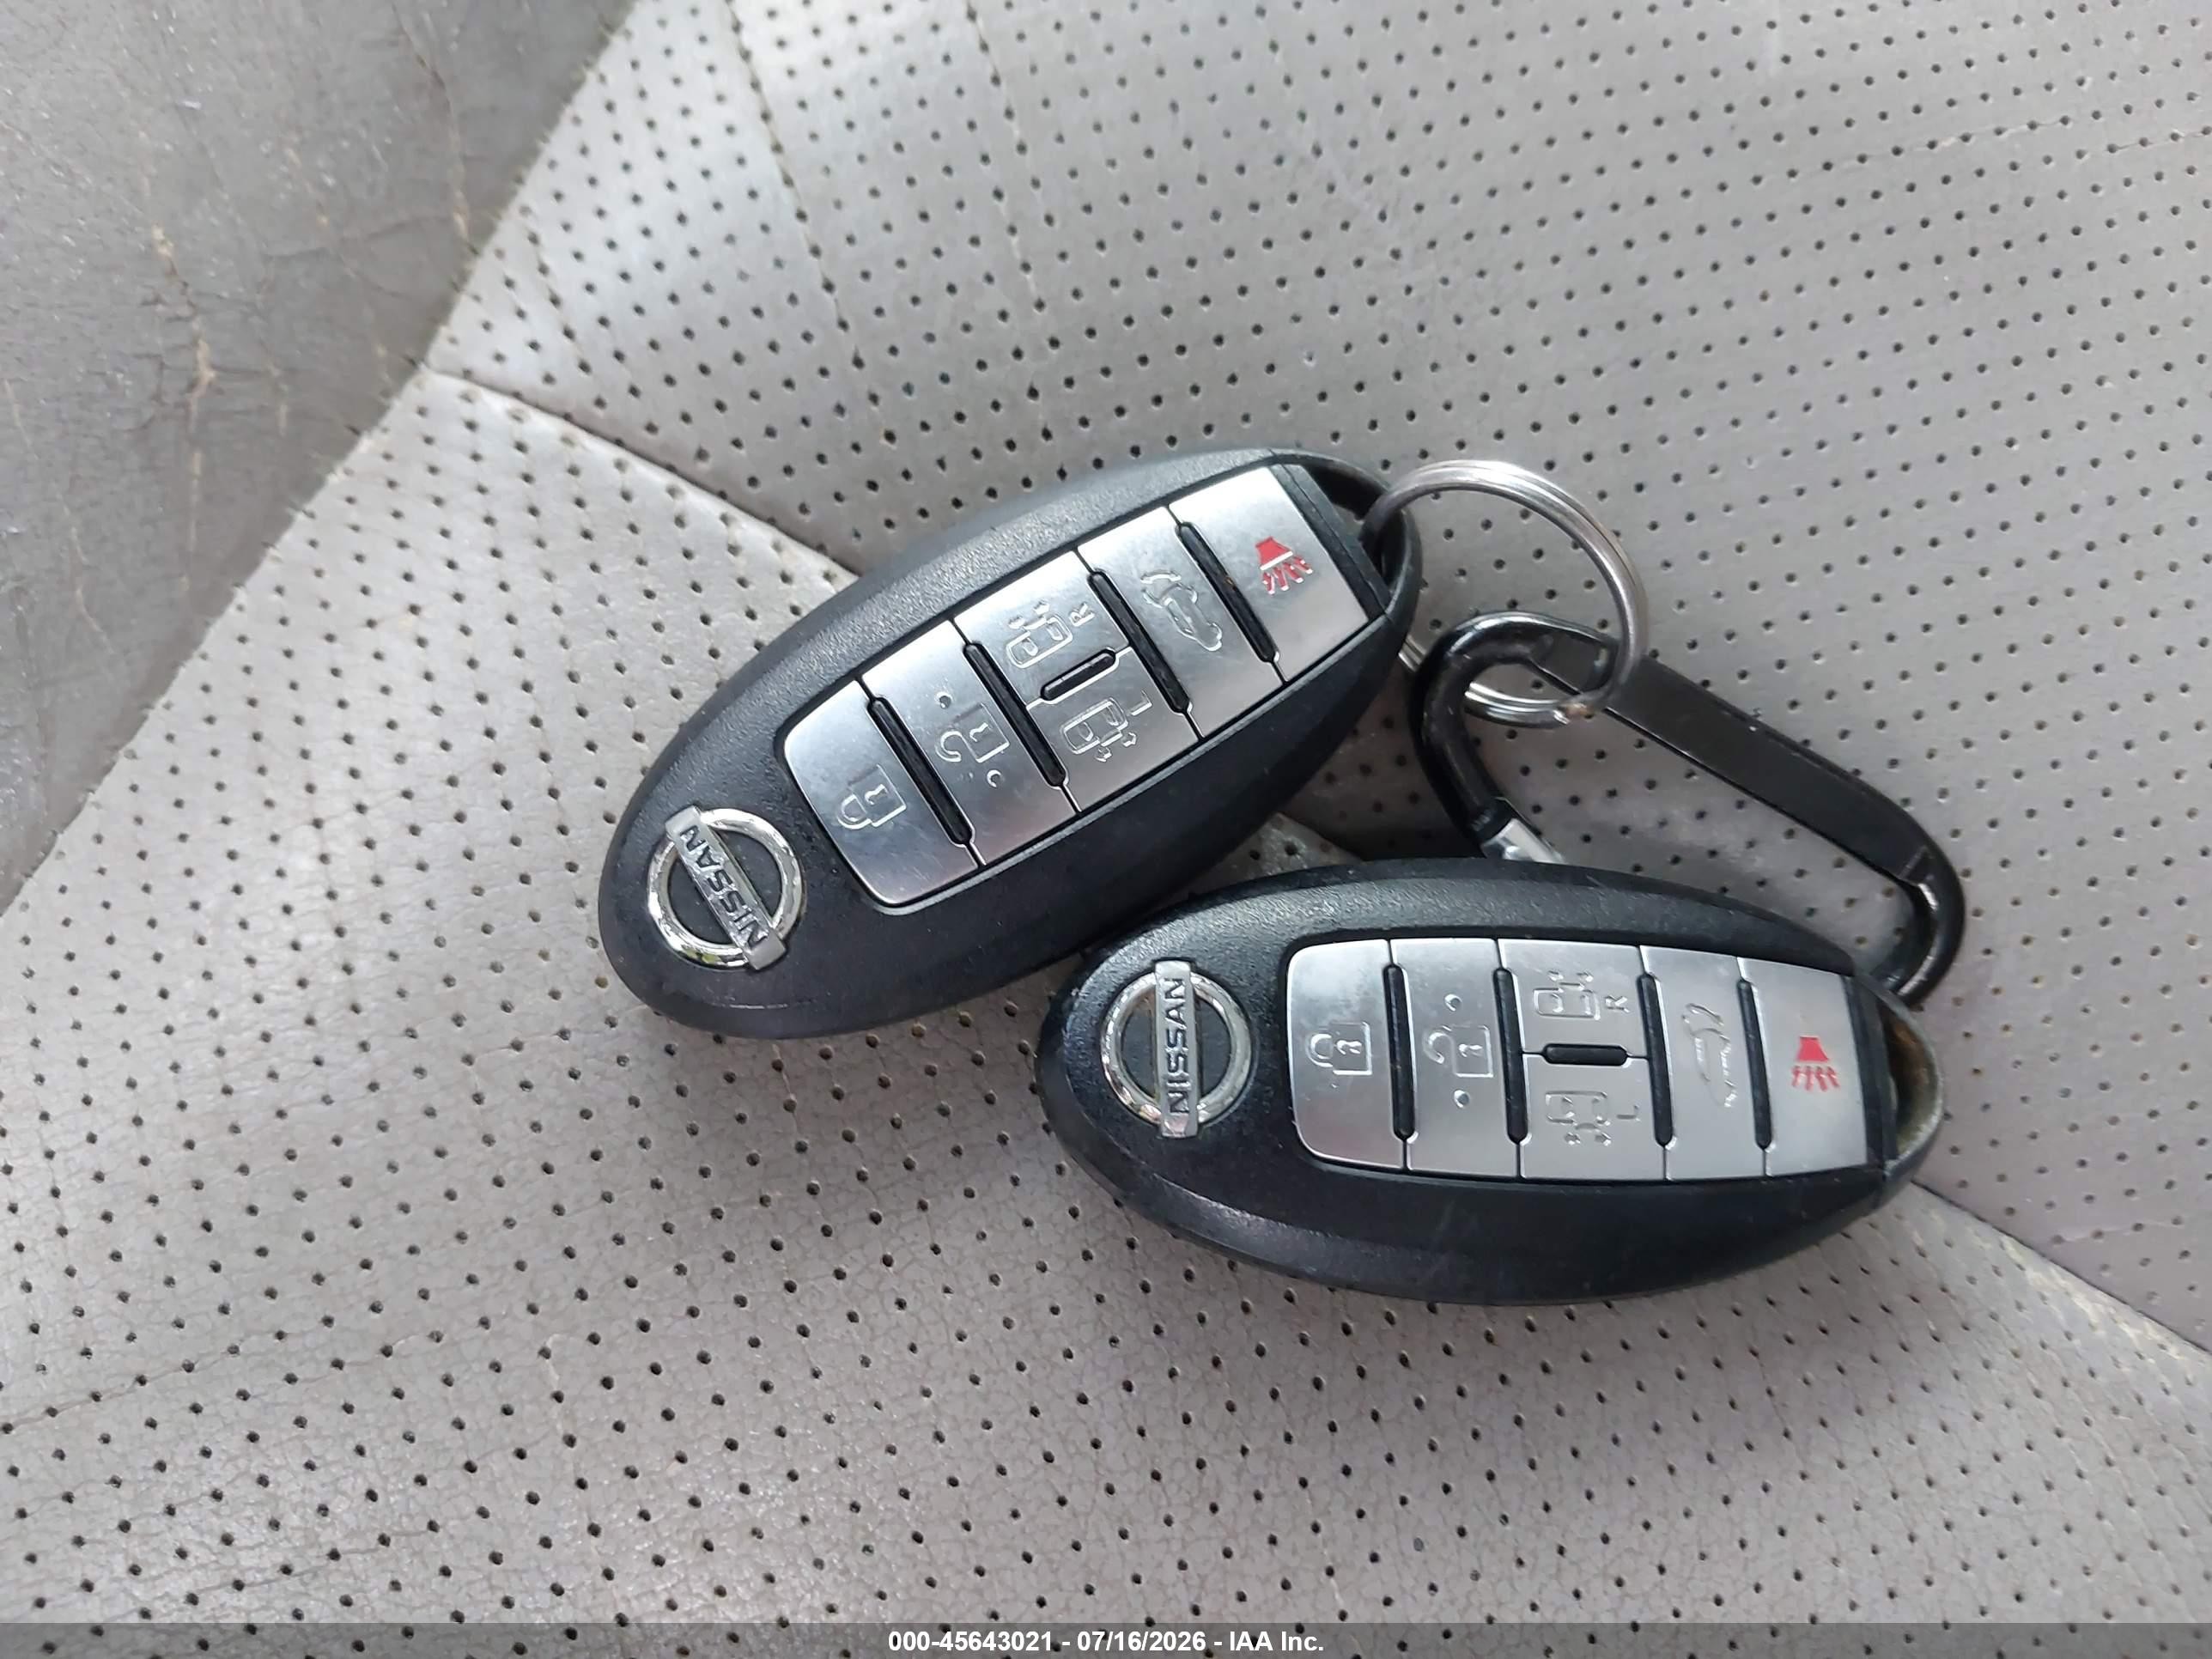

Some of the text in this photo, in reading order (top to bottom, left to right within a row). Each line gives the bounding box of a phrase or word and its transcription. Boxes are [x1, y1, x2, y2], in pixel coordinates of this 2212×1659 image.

[1071, 603, 1095, 627] R
[1130, 690, 1152, 716] L
[678, 824, 769, 946] NISSAN
[1605, 994, 1630, 1013] R
[1164, 977, 1192, 1114] NISSAN
